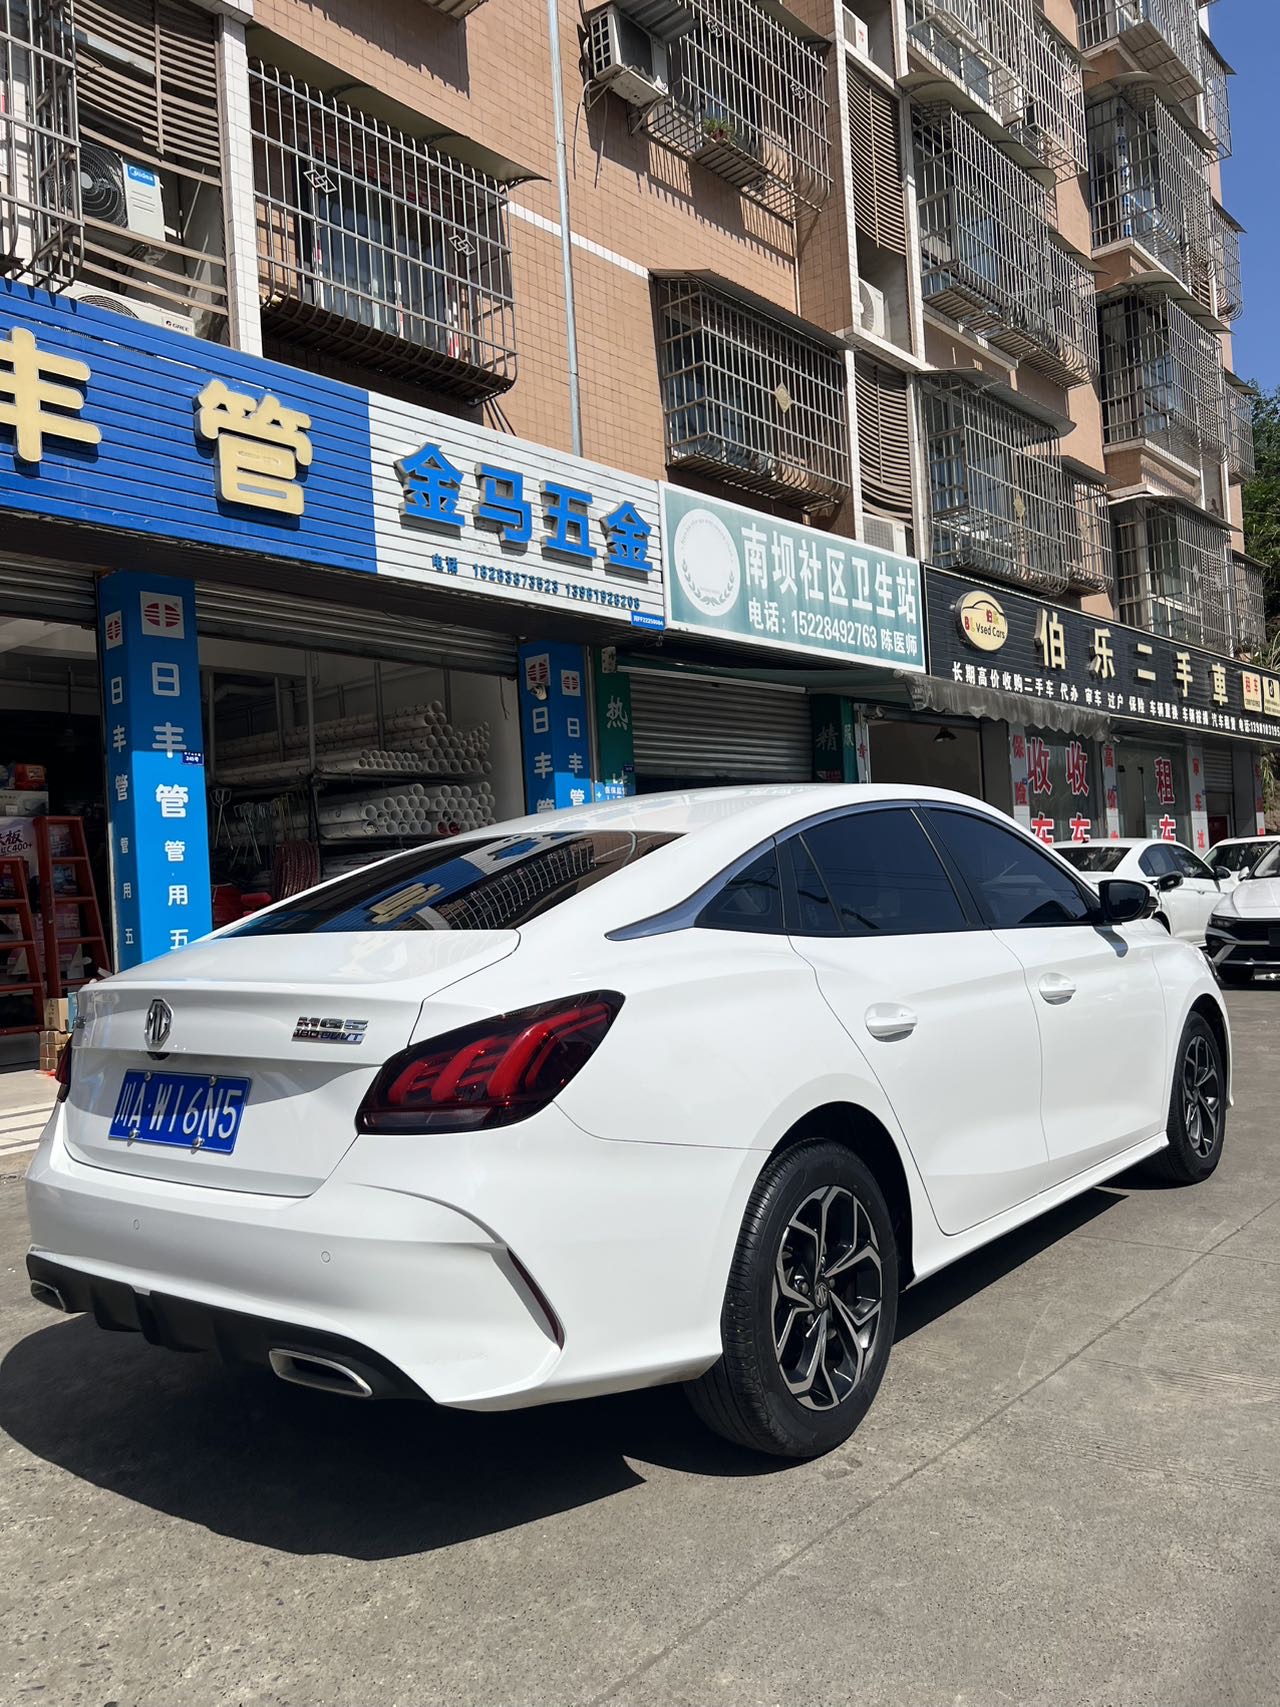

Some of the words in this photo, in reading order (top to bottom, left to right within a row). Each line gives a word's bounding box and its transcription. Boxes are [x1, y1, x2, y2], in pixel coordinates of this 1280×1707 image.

[394, 442, 652, 572] 金马五金
[741, 523, 917, 625] 南坝社区卫生站
[792, 609, 877, 649] 15228492763
[881, 628, 918, 657] 陈医师
[952, 661, 1054, 698] 长期高价收购二手车
[1060, 682, 1079, 702] 代办
[1107, 692, 1123, 710] 过户
[1129, 696, 1145, 713] 保险
[111, 676, 128, 801] 日丰管
[152, 661, 190, 818] 日丰管
[567, 717, 585, 806] 日丰管
